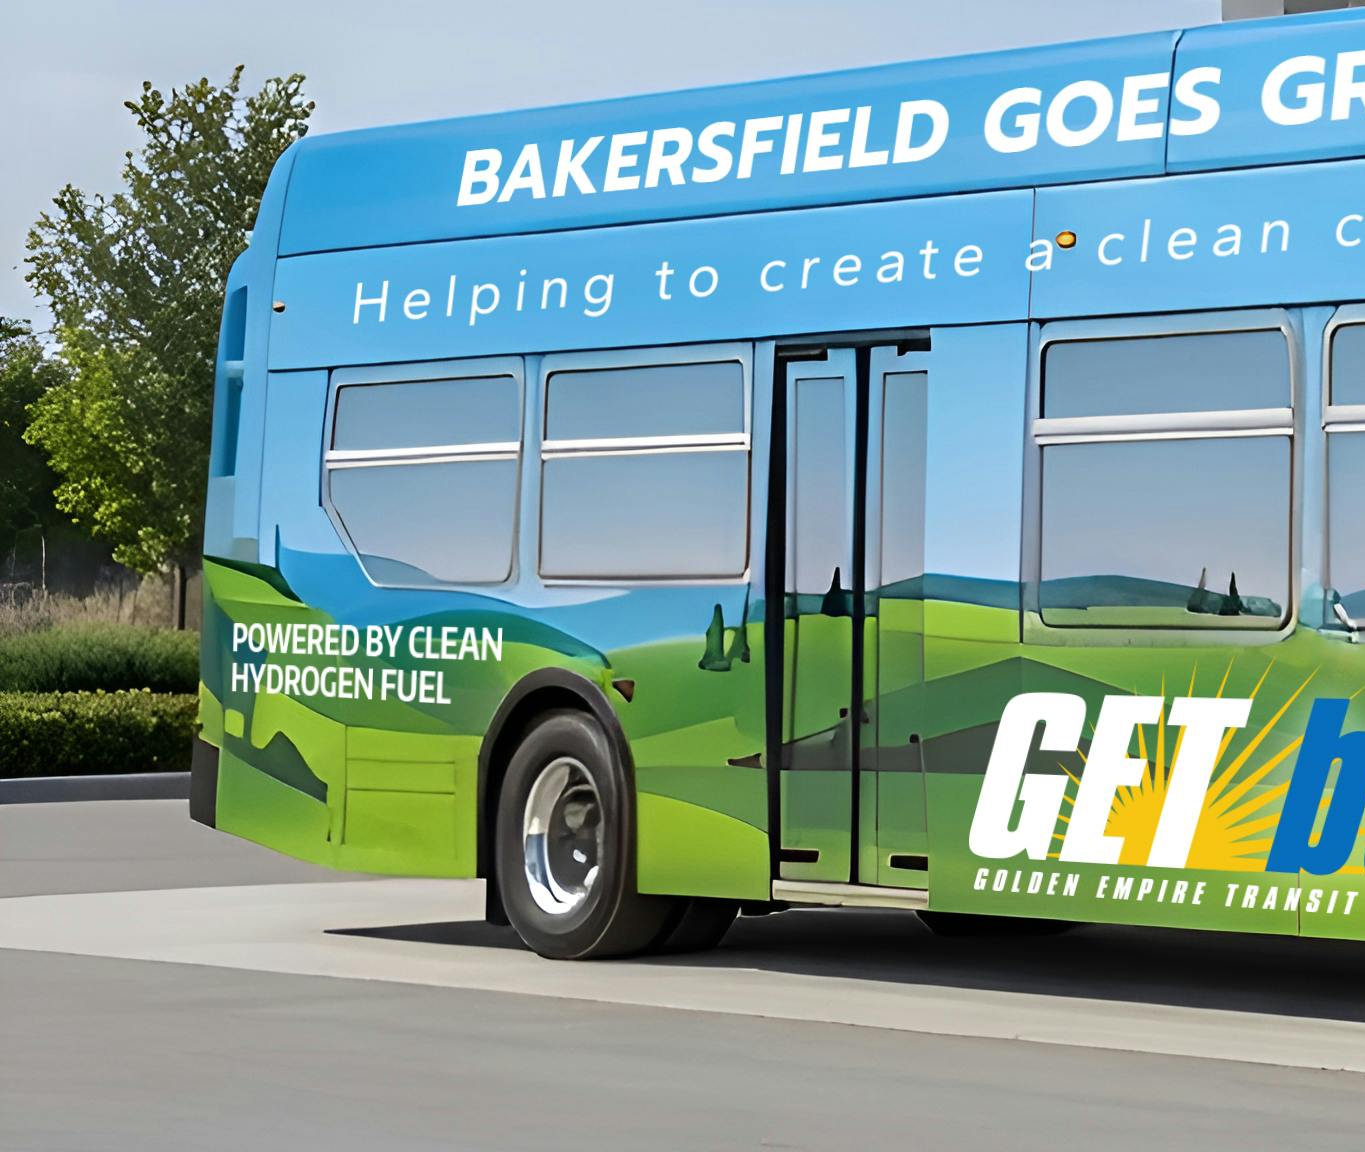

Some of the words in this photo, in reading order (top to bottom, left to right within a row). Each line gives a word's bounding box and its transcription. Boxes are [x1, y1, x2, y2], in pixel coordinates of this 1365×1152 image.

[457, 100, 949, 207] BAKERSFIELD
[985, 67, 1220, 152] GOES
[353, 269, 614, 326] Helping
[656, 262, 718, 299] to
[761, 241, 982, 291] create
[1025, 240, 1053, 271] a
[1098, 219, 1289, 265] clean
[233, 623, 359, 655] POWERED
[366, 626, 403, 657] BY
[409, 626, 502, 661] CLEAN
[232, 663, 373, 699] HYDROGEN
[381, 669, 451, 704] FUEL
[968, 692, 1252, 868] GET
[973, 867, 1079, 897] GOLDEN
[1096, 876, 1206, 904] EMPIRE
[1226, 884, 1358, 914] TRANSIT
